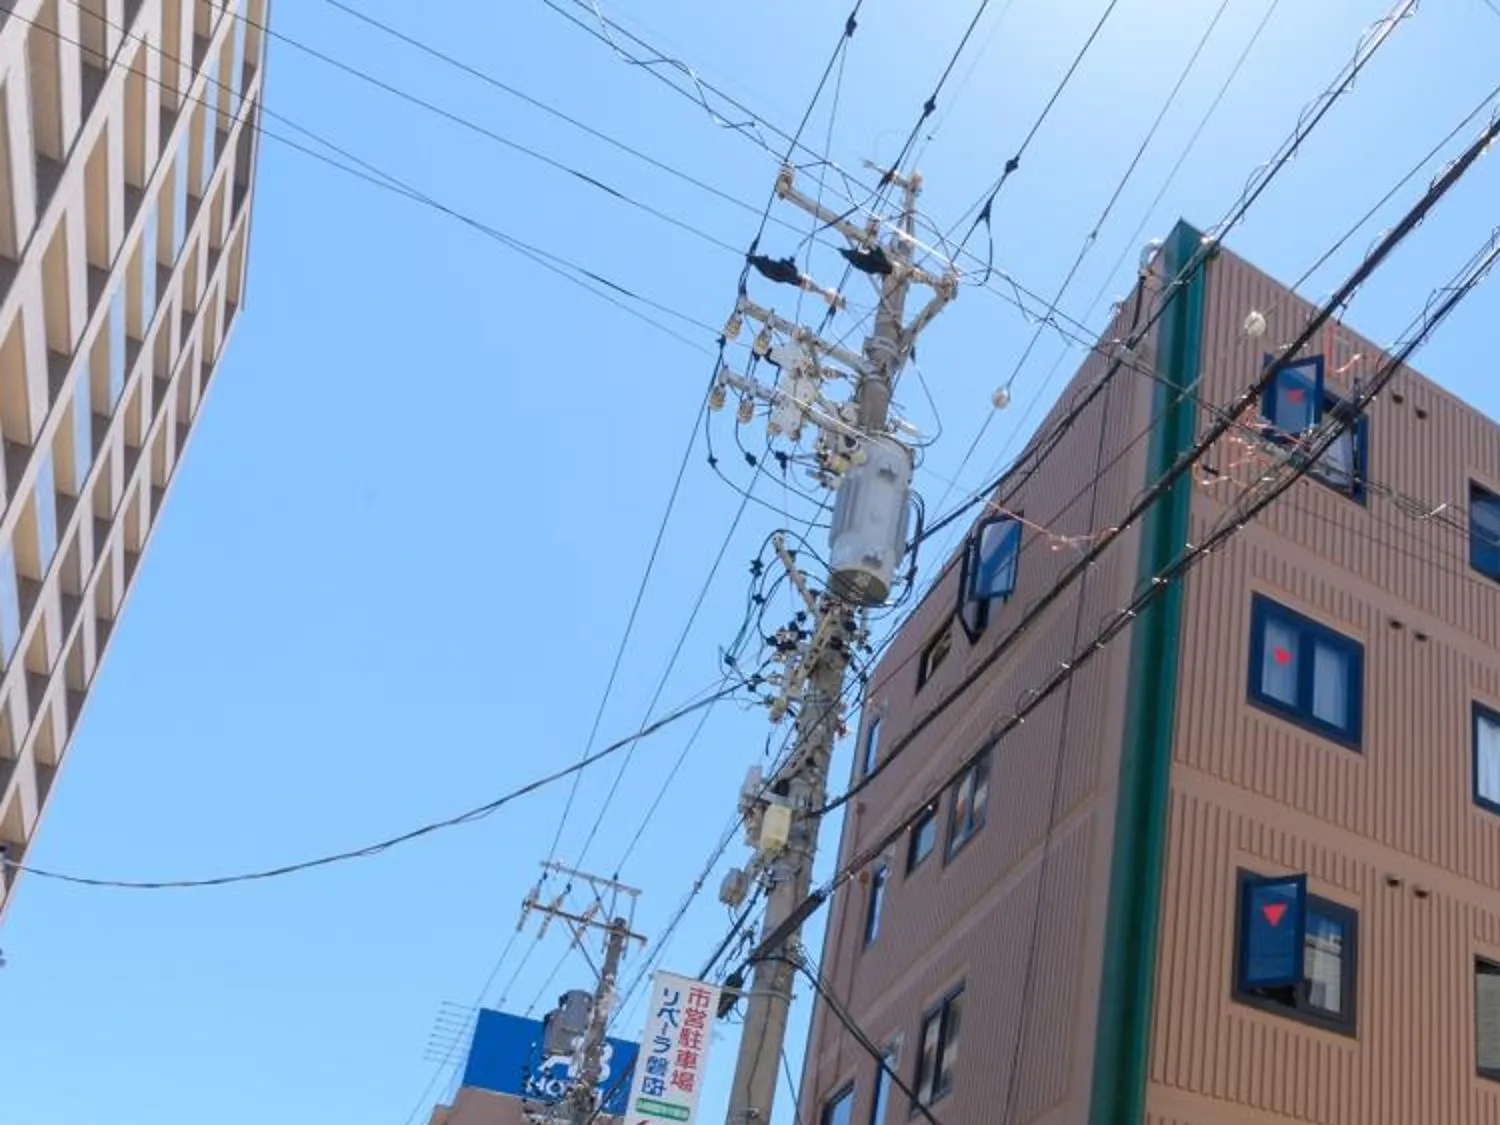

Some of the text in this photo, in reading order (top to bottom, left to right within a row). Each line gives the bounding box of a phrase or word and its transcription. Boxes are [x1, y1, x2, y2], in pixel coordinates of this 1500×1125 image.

[669, 986, 712, 1094] 市営駐車場
